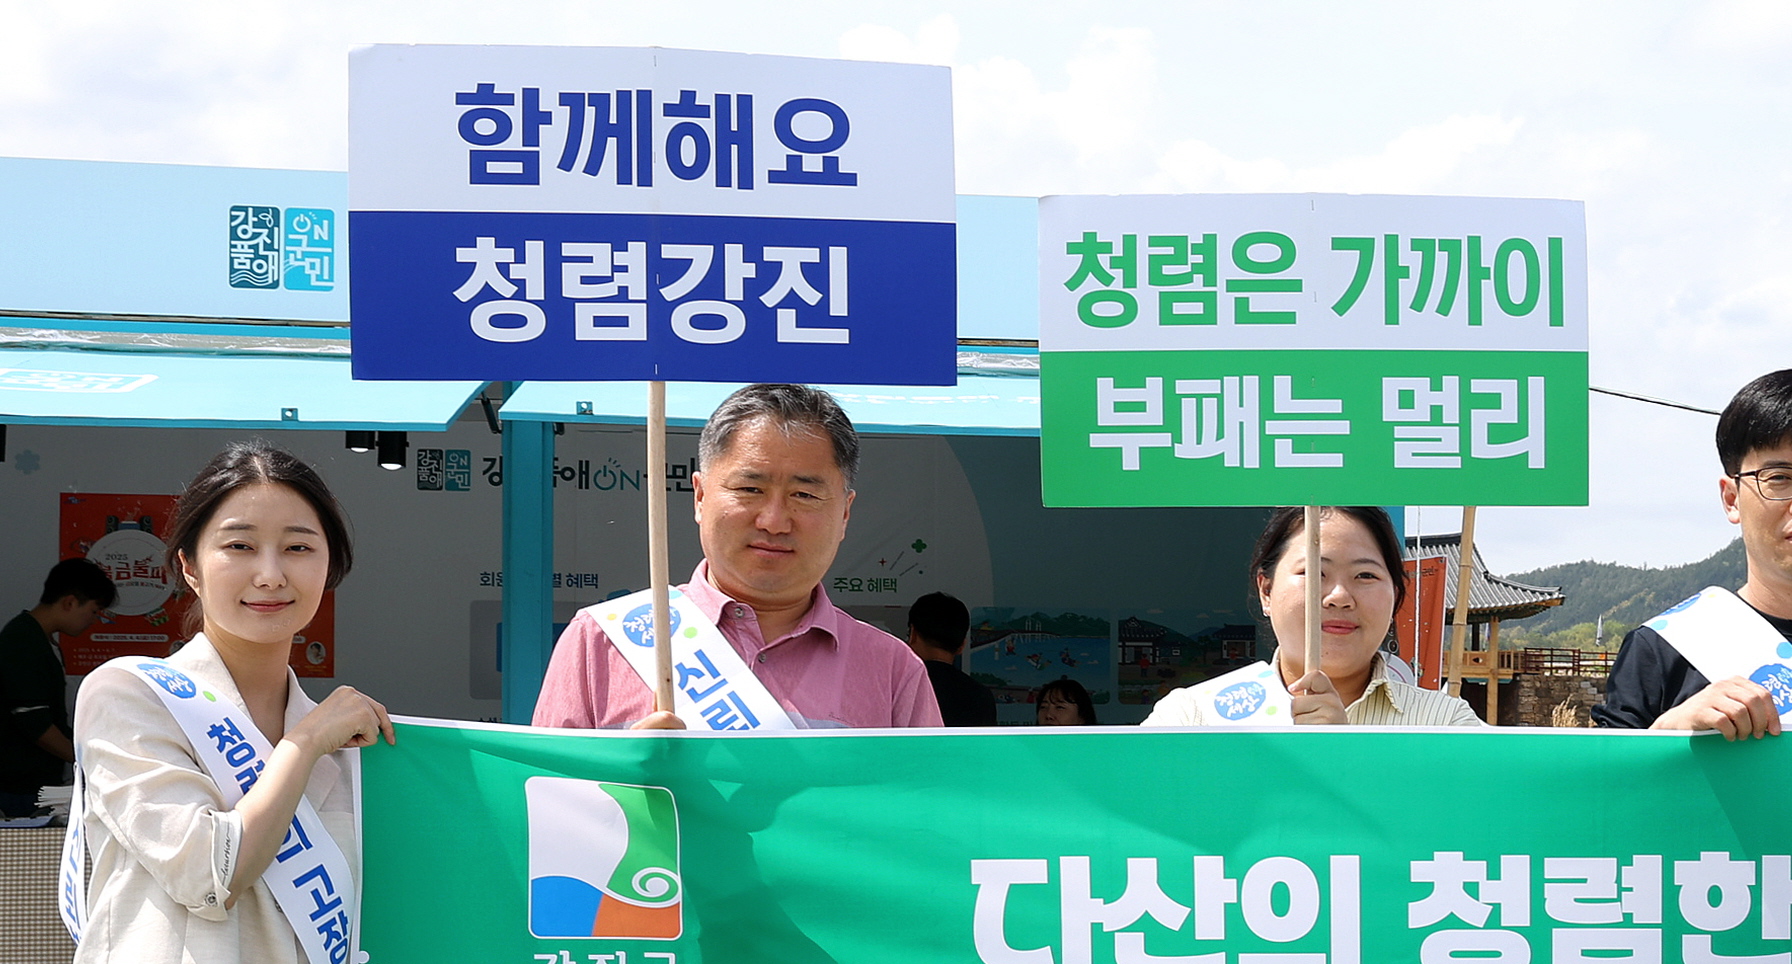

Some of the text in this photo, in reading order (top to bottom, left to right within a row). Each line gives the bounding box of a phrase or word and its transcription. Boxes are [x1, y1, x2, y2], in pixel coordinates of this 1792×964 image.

[454, 82, 859, 191] 함께해요
[452, 236, 851, 345] 청렴강진
[1063, 231, 1565, 329] 청렴은 가까이
[1089, 374, 1546, 471] 부패는 멀리
[566, 573, 598, 589] 혜택
[833, 577, 897, 593] 주요 혜택
